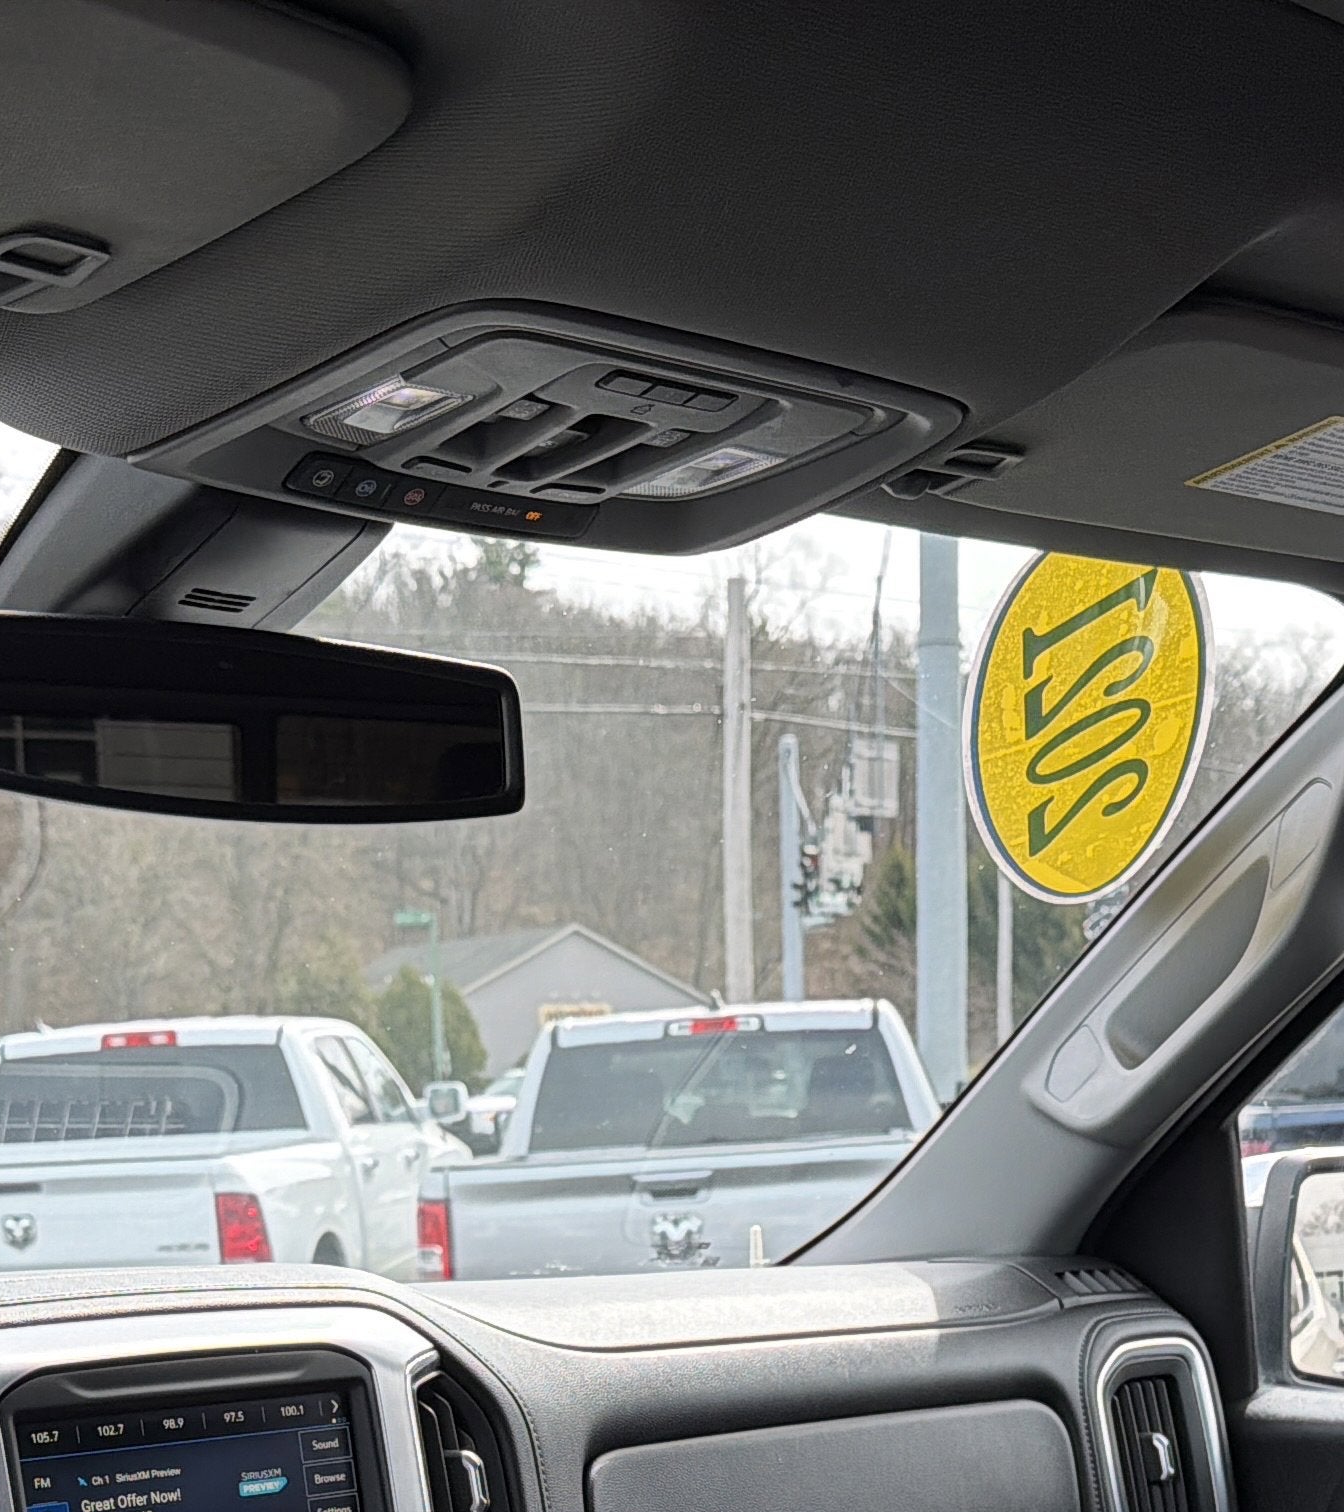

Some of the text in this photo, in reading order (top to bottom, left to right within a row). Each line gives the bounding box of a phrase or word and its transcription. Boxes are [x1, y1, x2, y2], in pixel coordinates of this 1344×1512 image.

[525, 510, 543, 521] OFF
[30, 1404, 305, 1445] 105.7 102.7 98.9 97.5 100.1
[311, 1437, 340, 1451] Sound
[91, 1467, 182, 1486] Ch 1 SiriusXM Preview
[240, 1467, 282, 1481] SIRIUSXM
[313, 1471, 347, 1485] Browse
[33, 1477, 52, 1490] FM
[117, 1491, 148, 1510] Offer
[150, 1487, 182, 1505] Now!
